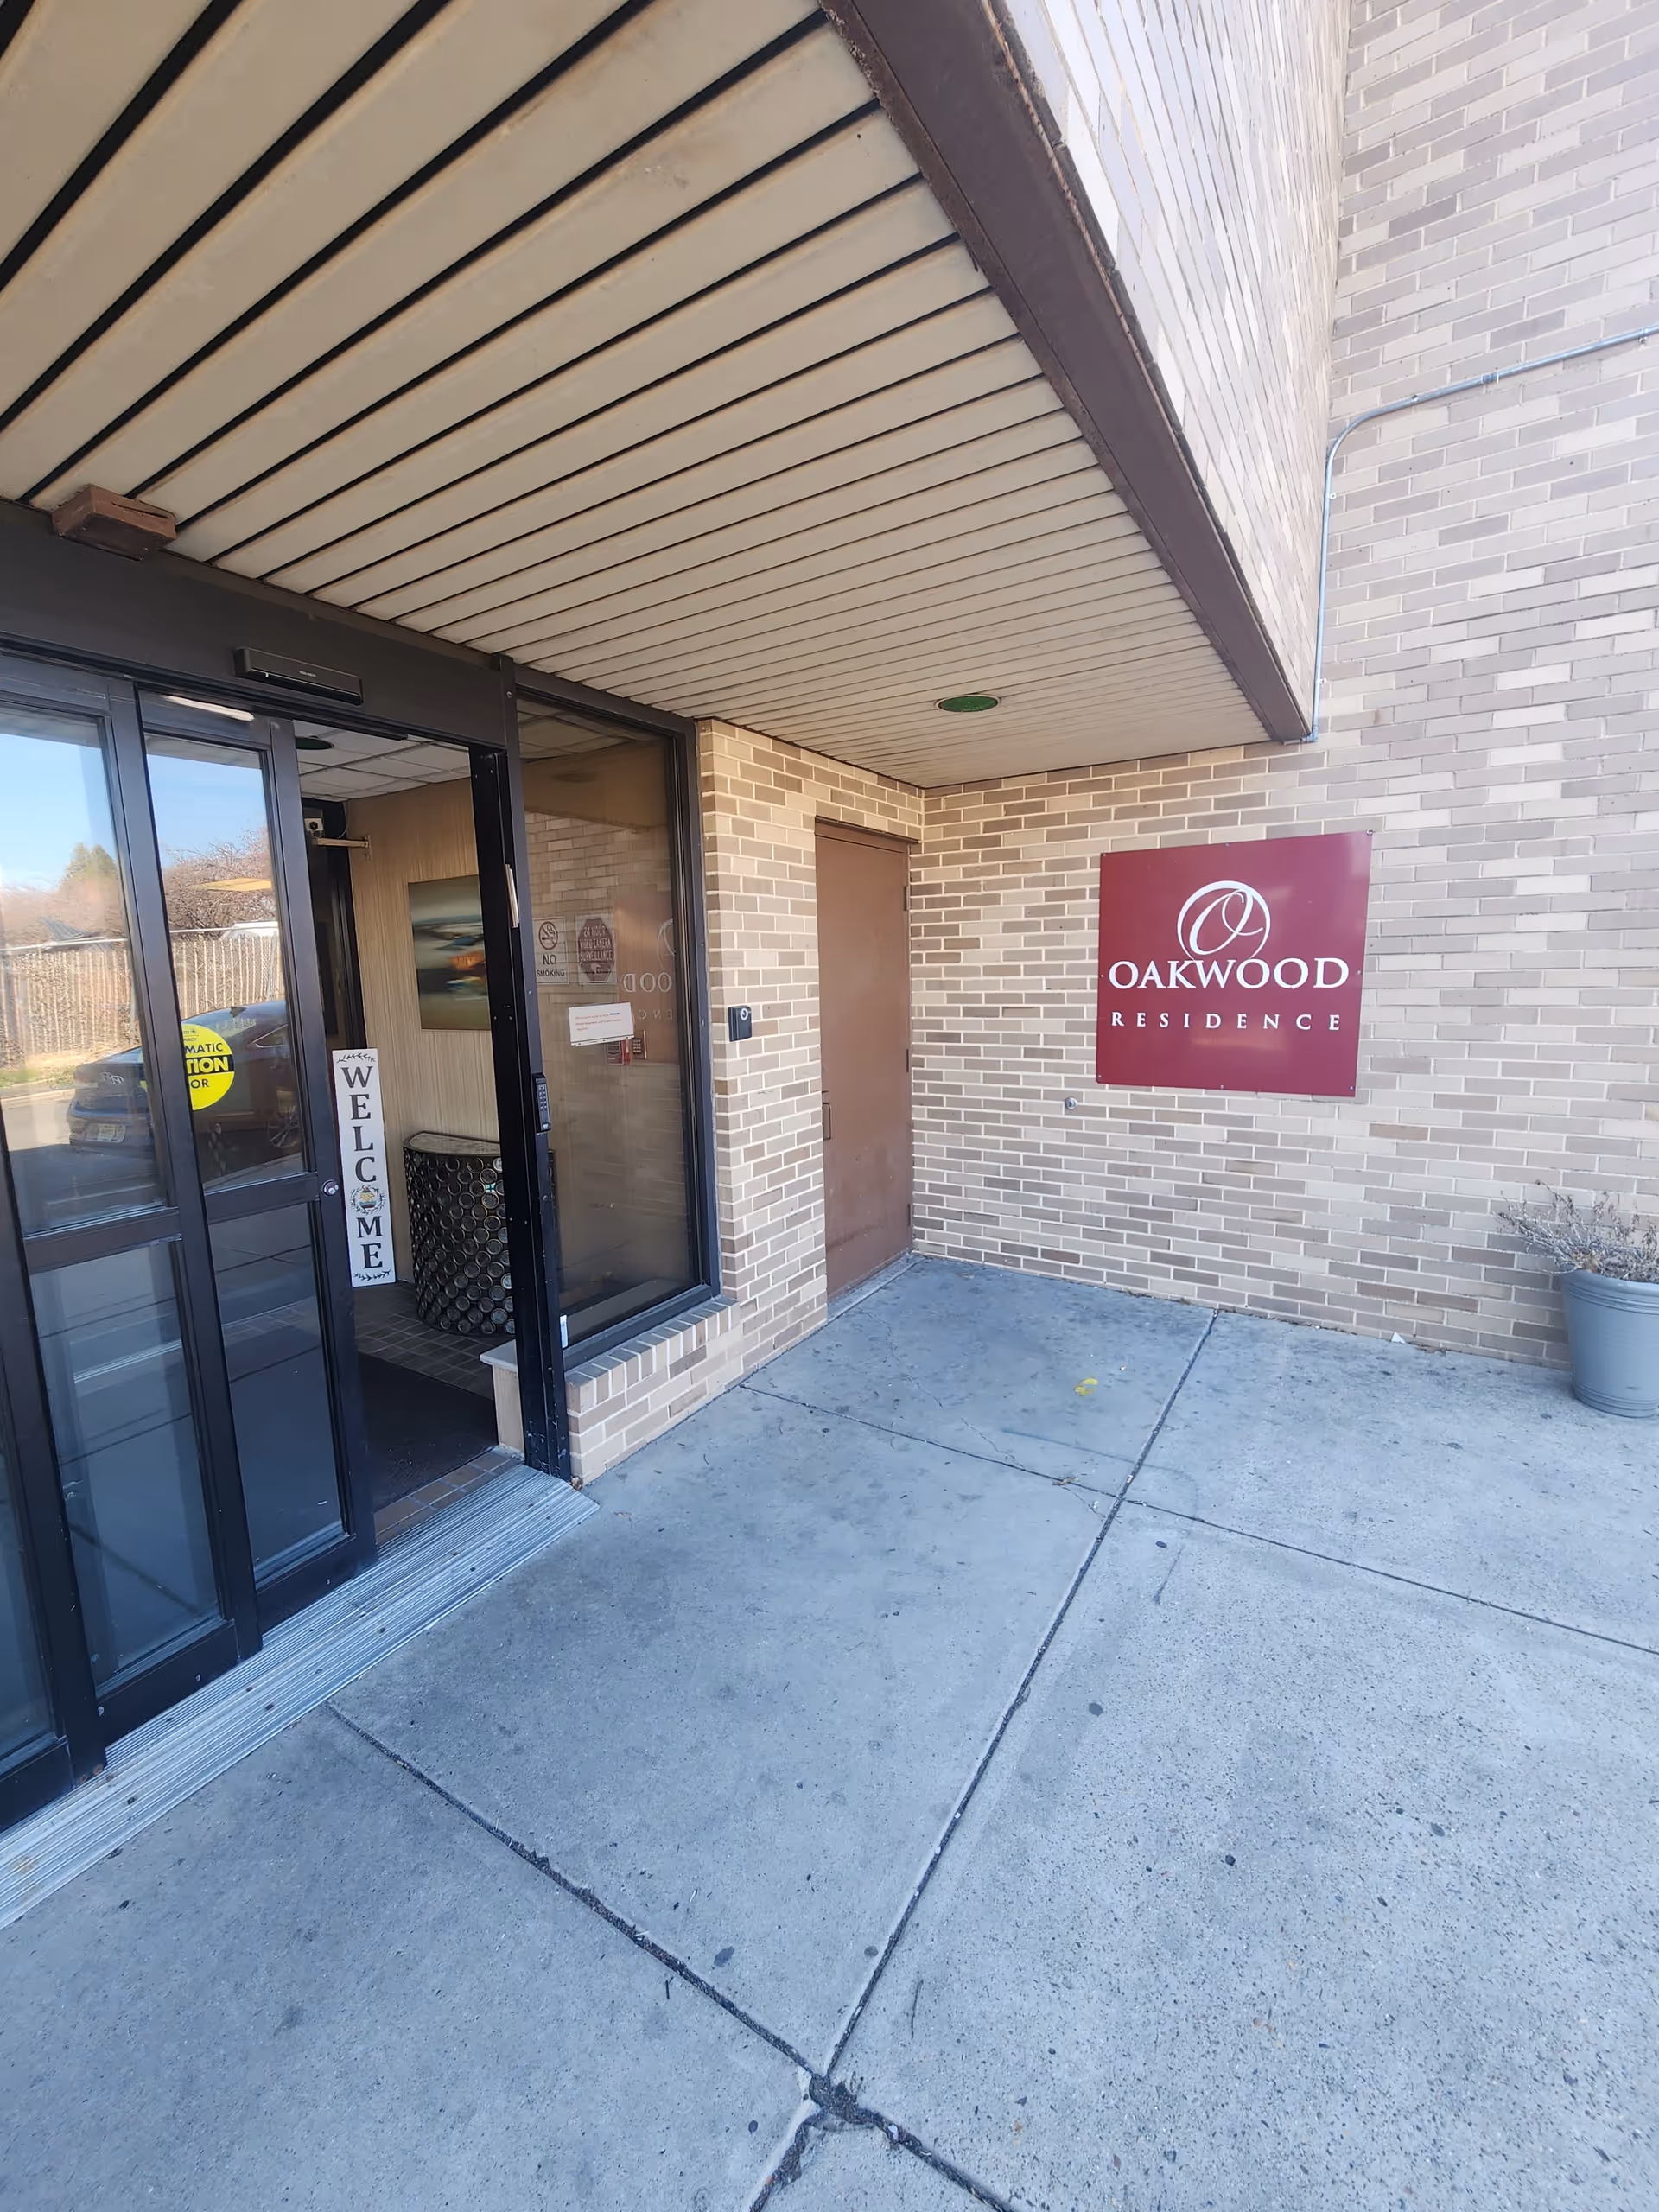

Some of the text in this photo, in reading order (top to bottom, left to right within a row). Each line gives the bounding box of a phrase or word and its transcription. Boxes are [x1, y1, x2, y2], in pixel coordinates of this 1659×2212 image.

[543, 954, 556, 965] NO
[537, 969, 565, 977] SMOKING
[1109, 957, 1350, 990] OAKWOOD
[1111, 1012, 1340, 1032] RESIDENCE
[185, 1042, 223, 1054] MATIC
[186, 1056, 229, 1074] TION
[190, 1078, 209, 1089] OR
